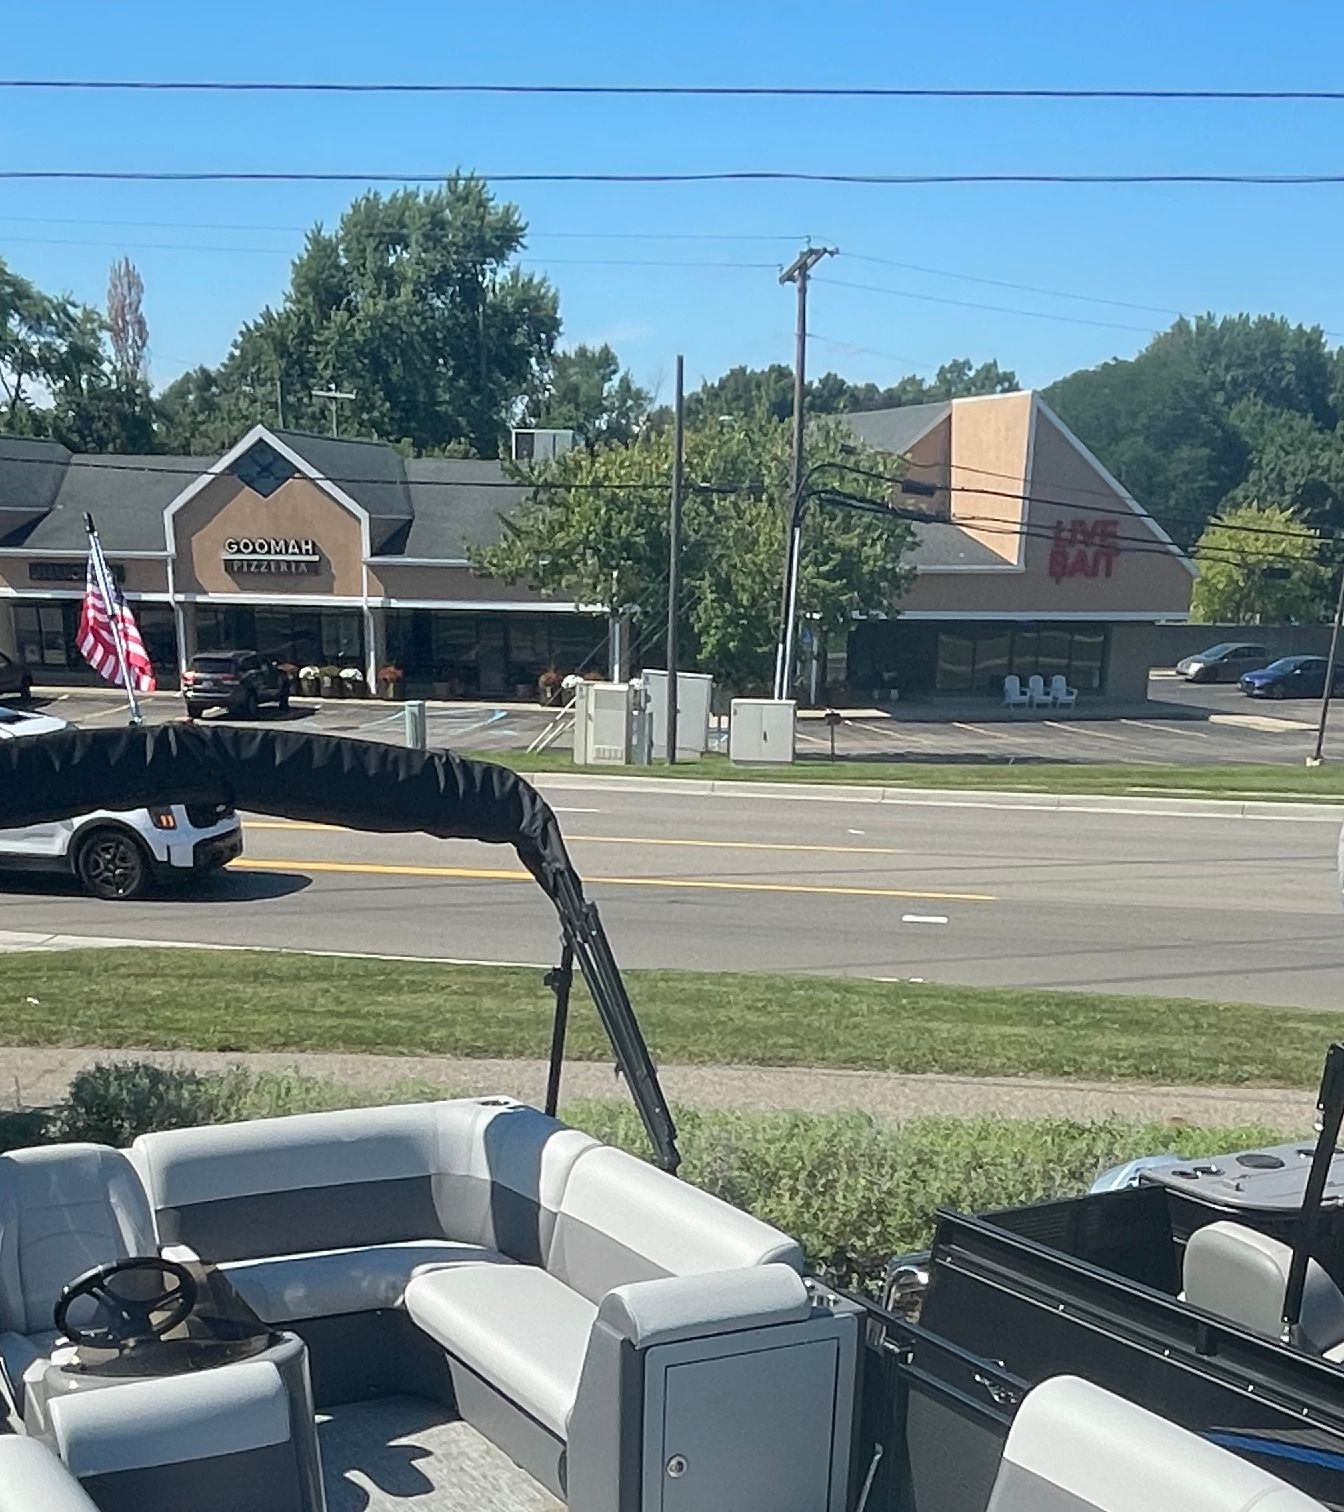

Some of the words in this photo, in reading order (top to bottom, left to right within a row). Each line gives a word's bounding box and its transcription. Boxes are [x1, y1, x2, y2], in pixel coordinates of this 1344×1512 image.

[1055, 519, 1120, 549] LIVE
[225, 538, 313, 555] GOOMAH
[233, 560, 308, 574] PIZZERIA
[1049, 549, 1120, 579] BAIT
